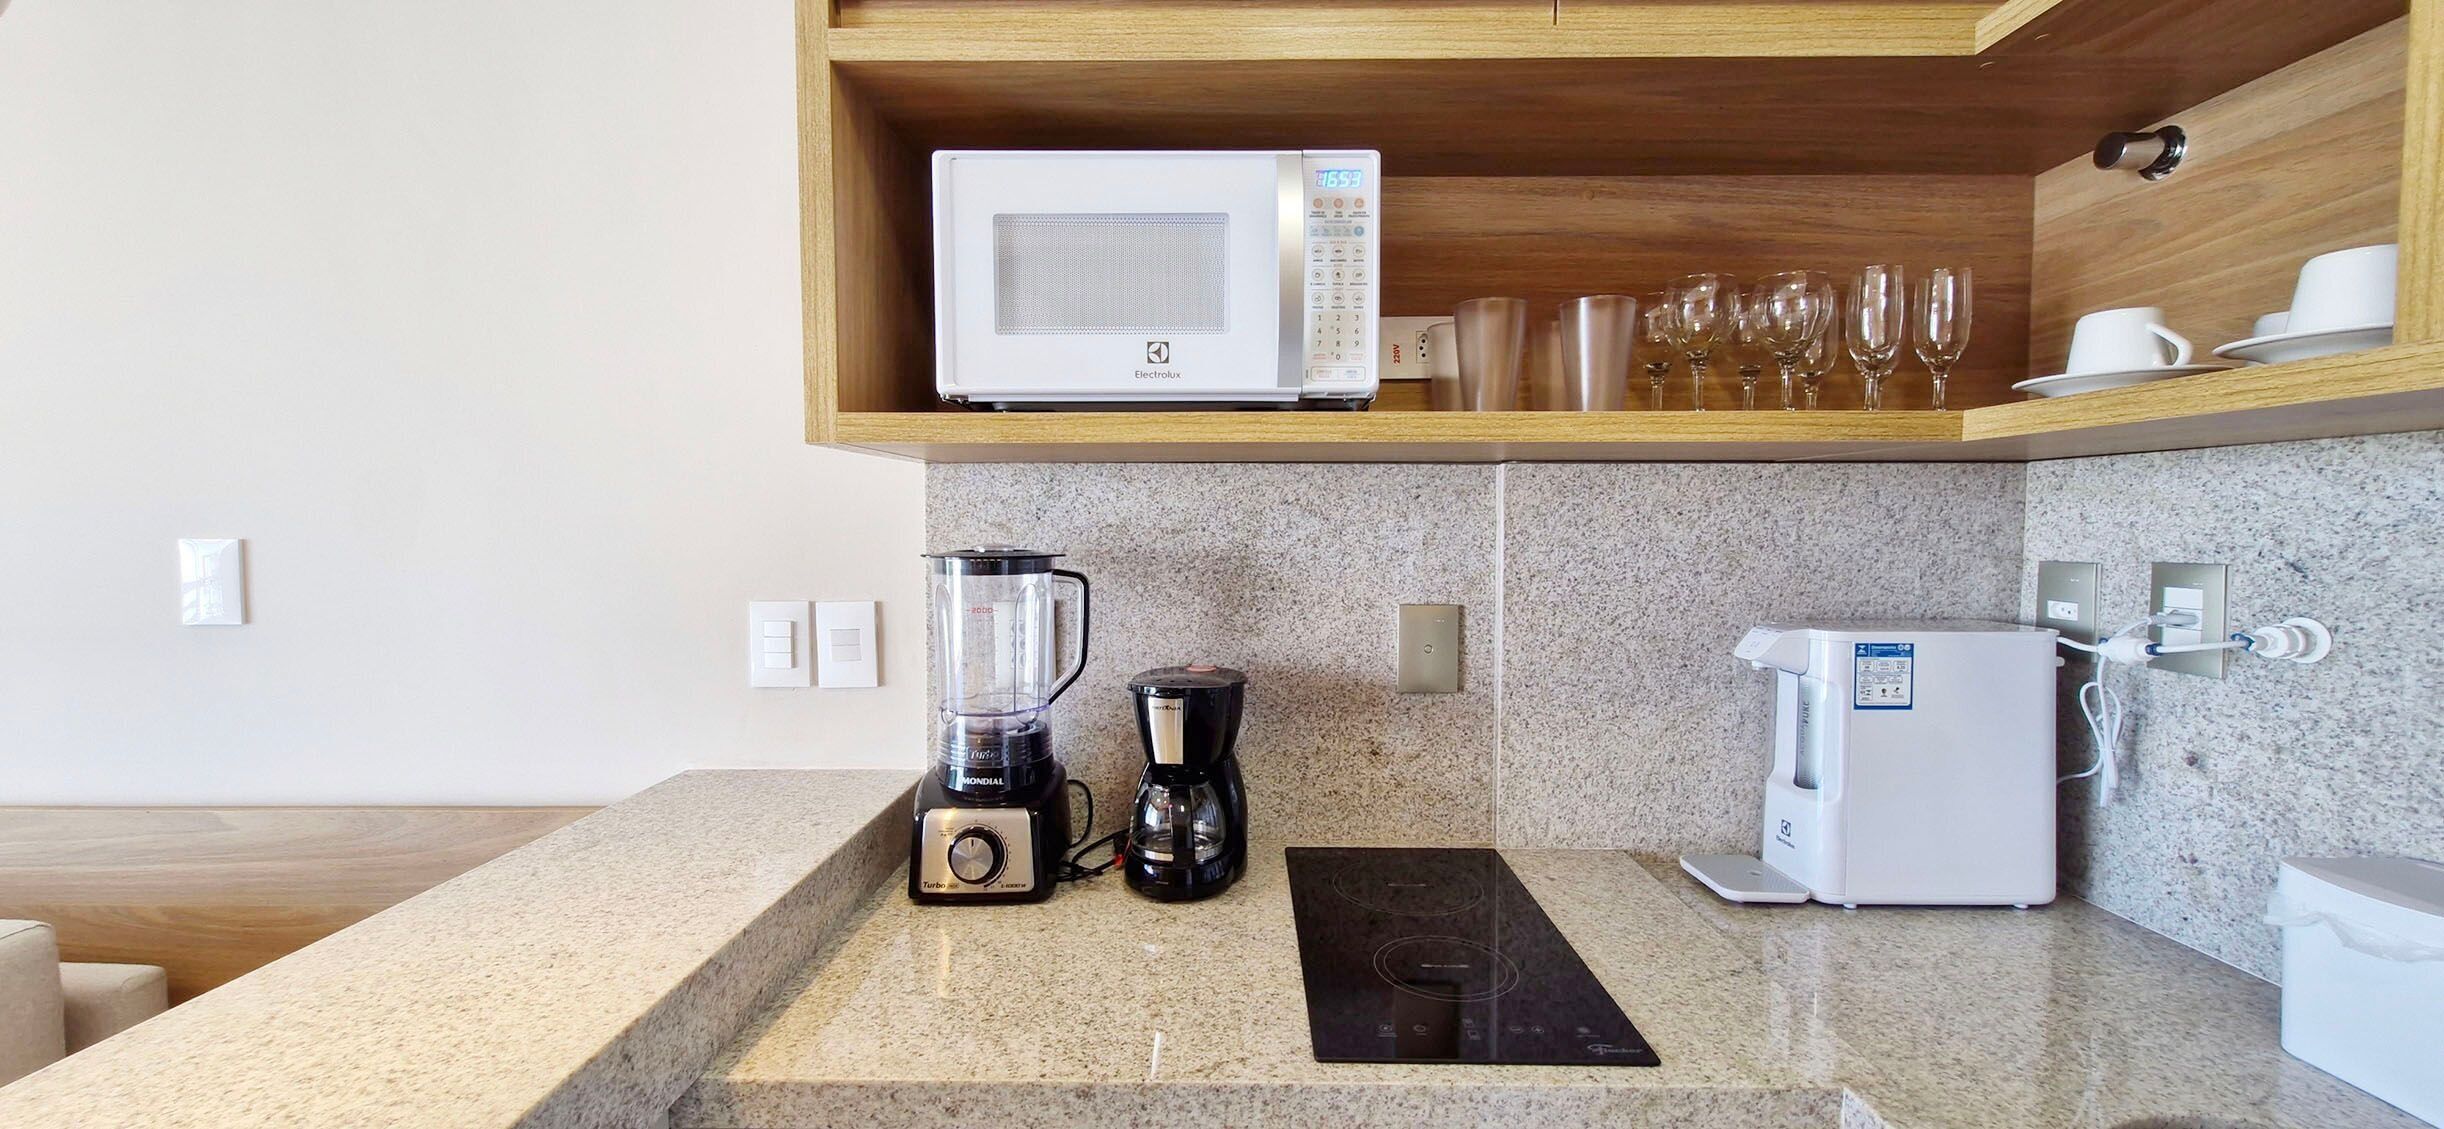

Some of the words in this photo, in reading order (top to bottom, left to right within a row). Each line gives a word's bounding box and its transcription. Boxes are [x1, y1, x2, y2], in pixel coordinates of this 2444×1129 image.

[1135, 370, 1181, 379] Electrolux
[962, 776, 1005, 786] MONDIAL
[922, 881, 946, 889] Turbo
